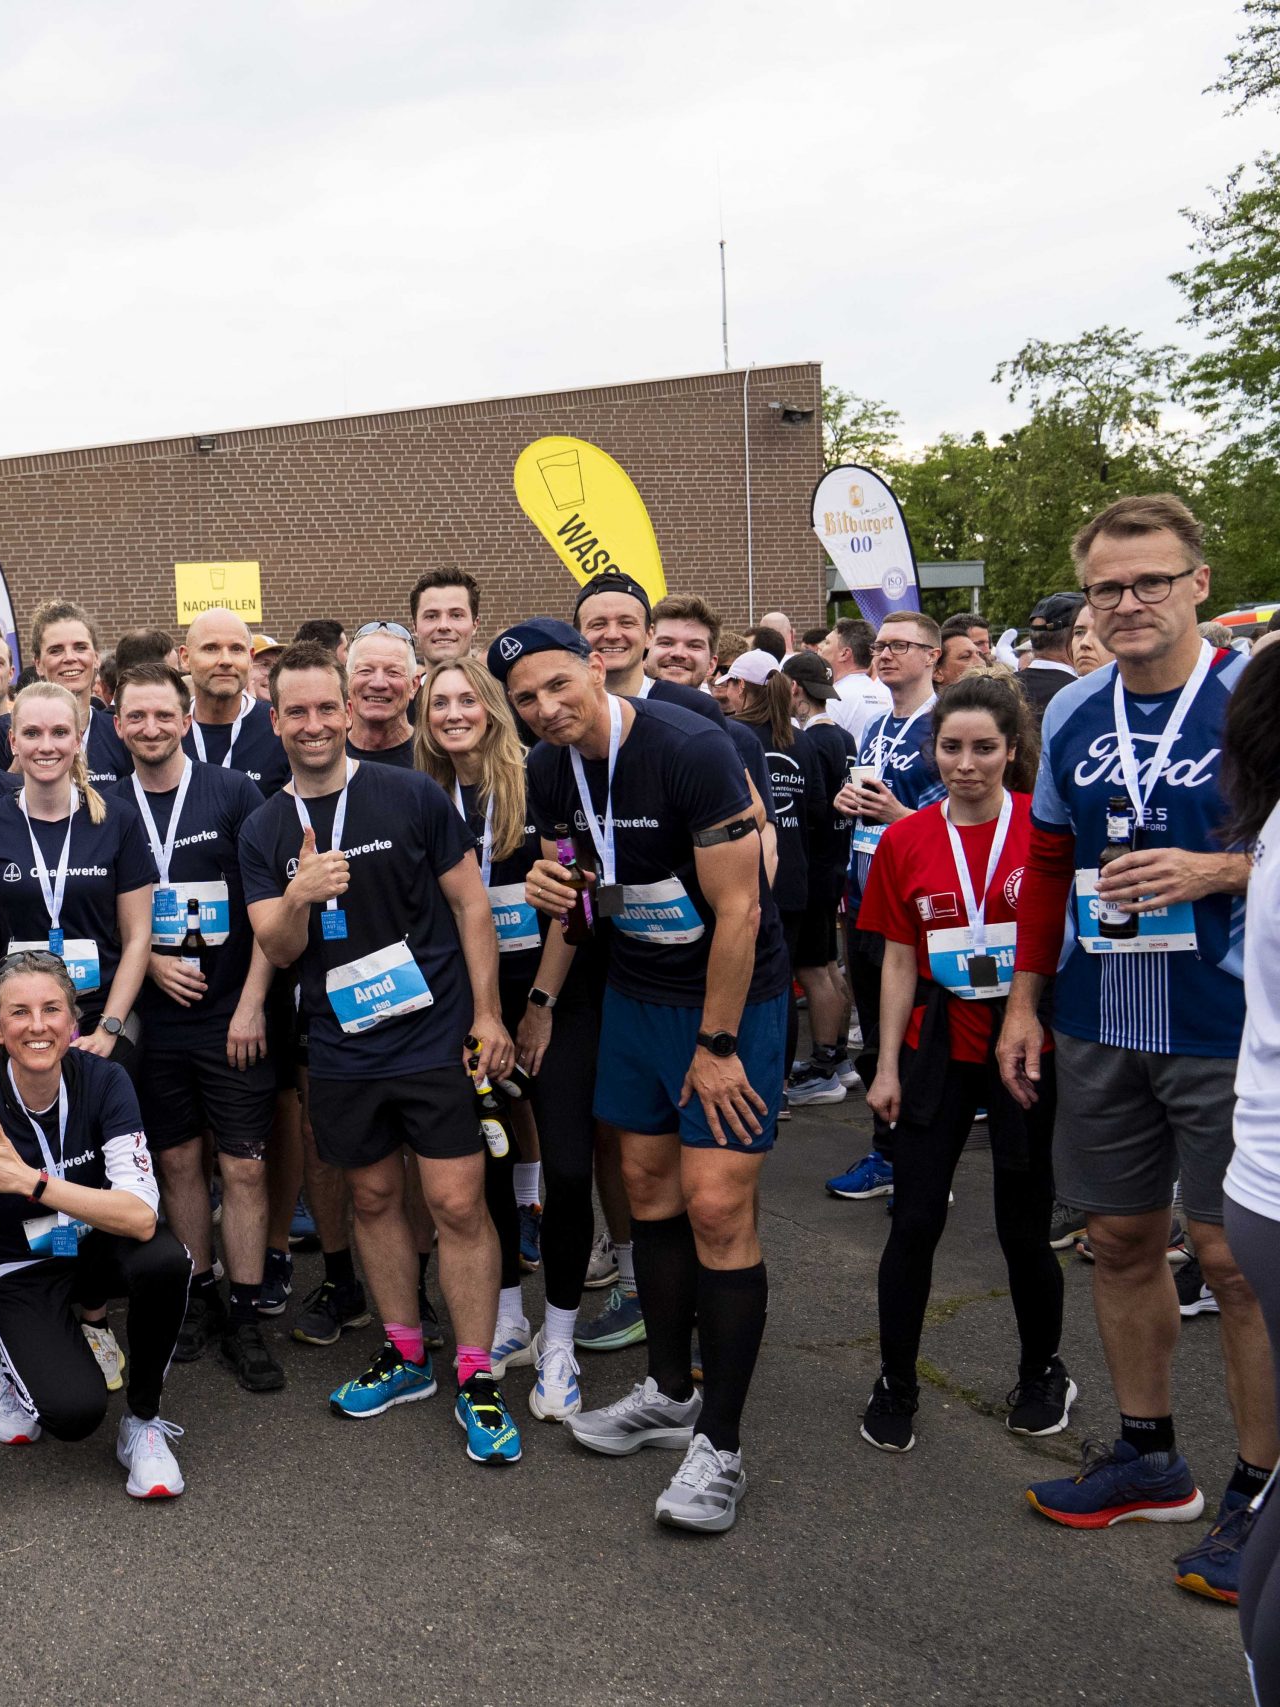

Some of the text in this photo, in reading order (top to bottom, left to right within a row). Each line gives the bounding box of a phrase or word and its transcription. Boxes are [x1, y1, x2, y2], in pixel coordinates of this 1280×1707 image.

[824, 510, 894, 536] Bitburger
[851, 535, 872, 553] 0.0
[183, 597, 256, 612] NACHFÜLLEN
[1074, 732, 1224, 787] Ford
[87, 772, 117, 782] zwerke
[771, 773, 805, 786] GmbH
[1106, 807, 1168, 821] 025
[344, 839, 392, 859] zwerke
[354, 975, 396, 1005] Arnd
[1124, 1418, 1156, 1430] SOCKS
[492, 1427, 517, 1450] BROOKS
[1247, 1468, 1271, 1480] SOC
